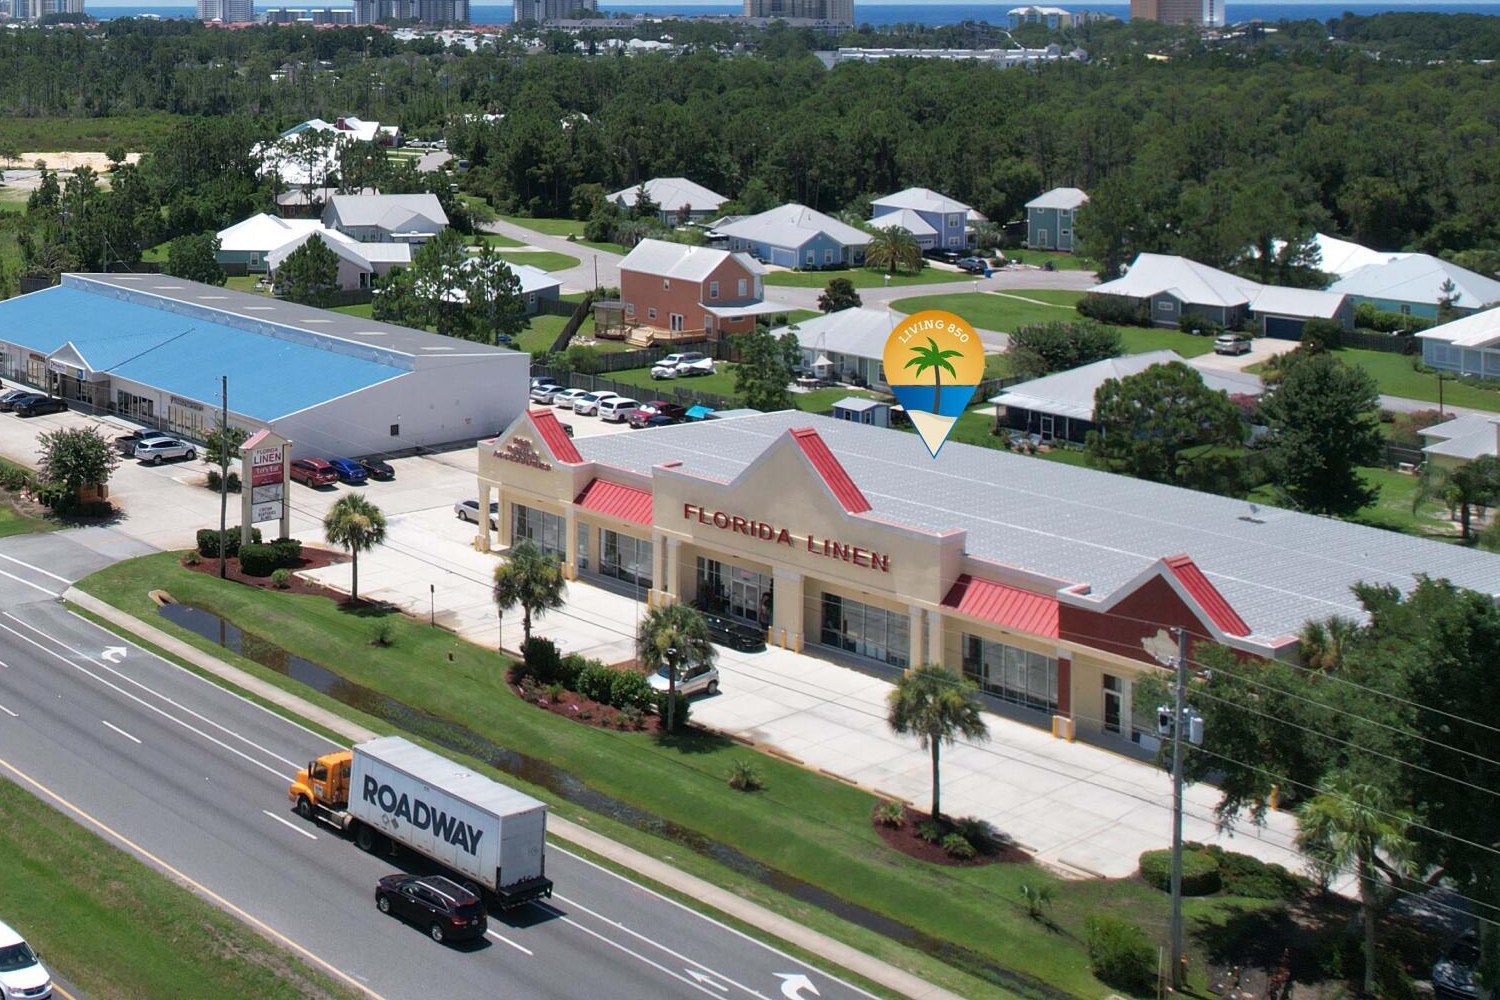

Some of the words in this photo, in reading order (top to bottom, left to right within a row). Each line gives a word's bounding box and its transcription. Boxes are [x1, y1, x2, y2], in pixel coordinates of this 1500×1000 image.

[254, 453, 282, 464] LINEN
[257, 447, 278, 455] FLORIDA
[684, 503, 794, 547] FLORIDA
[807, 534, 890, 573] LINEN
[363, 774, 483, 856] ROADWAY
